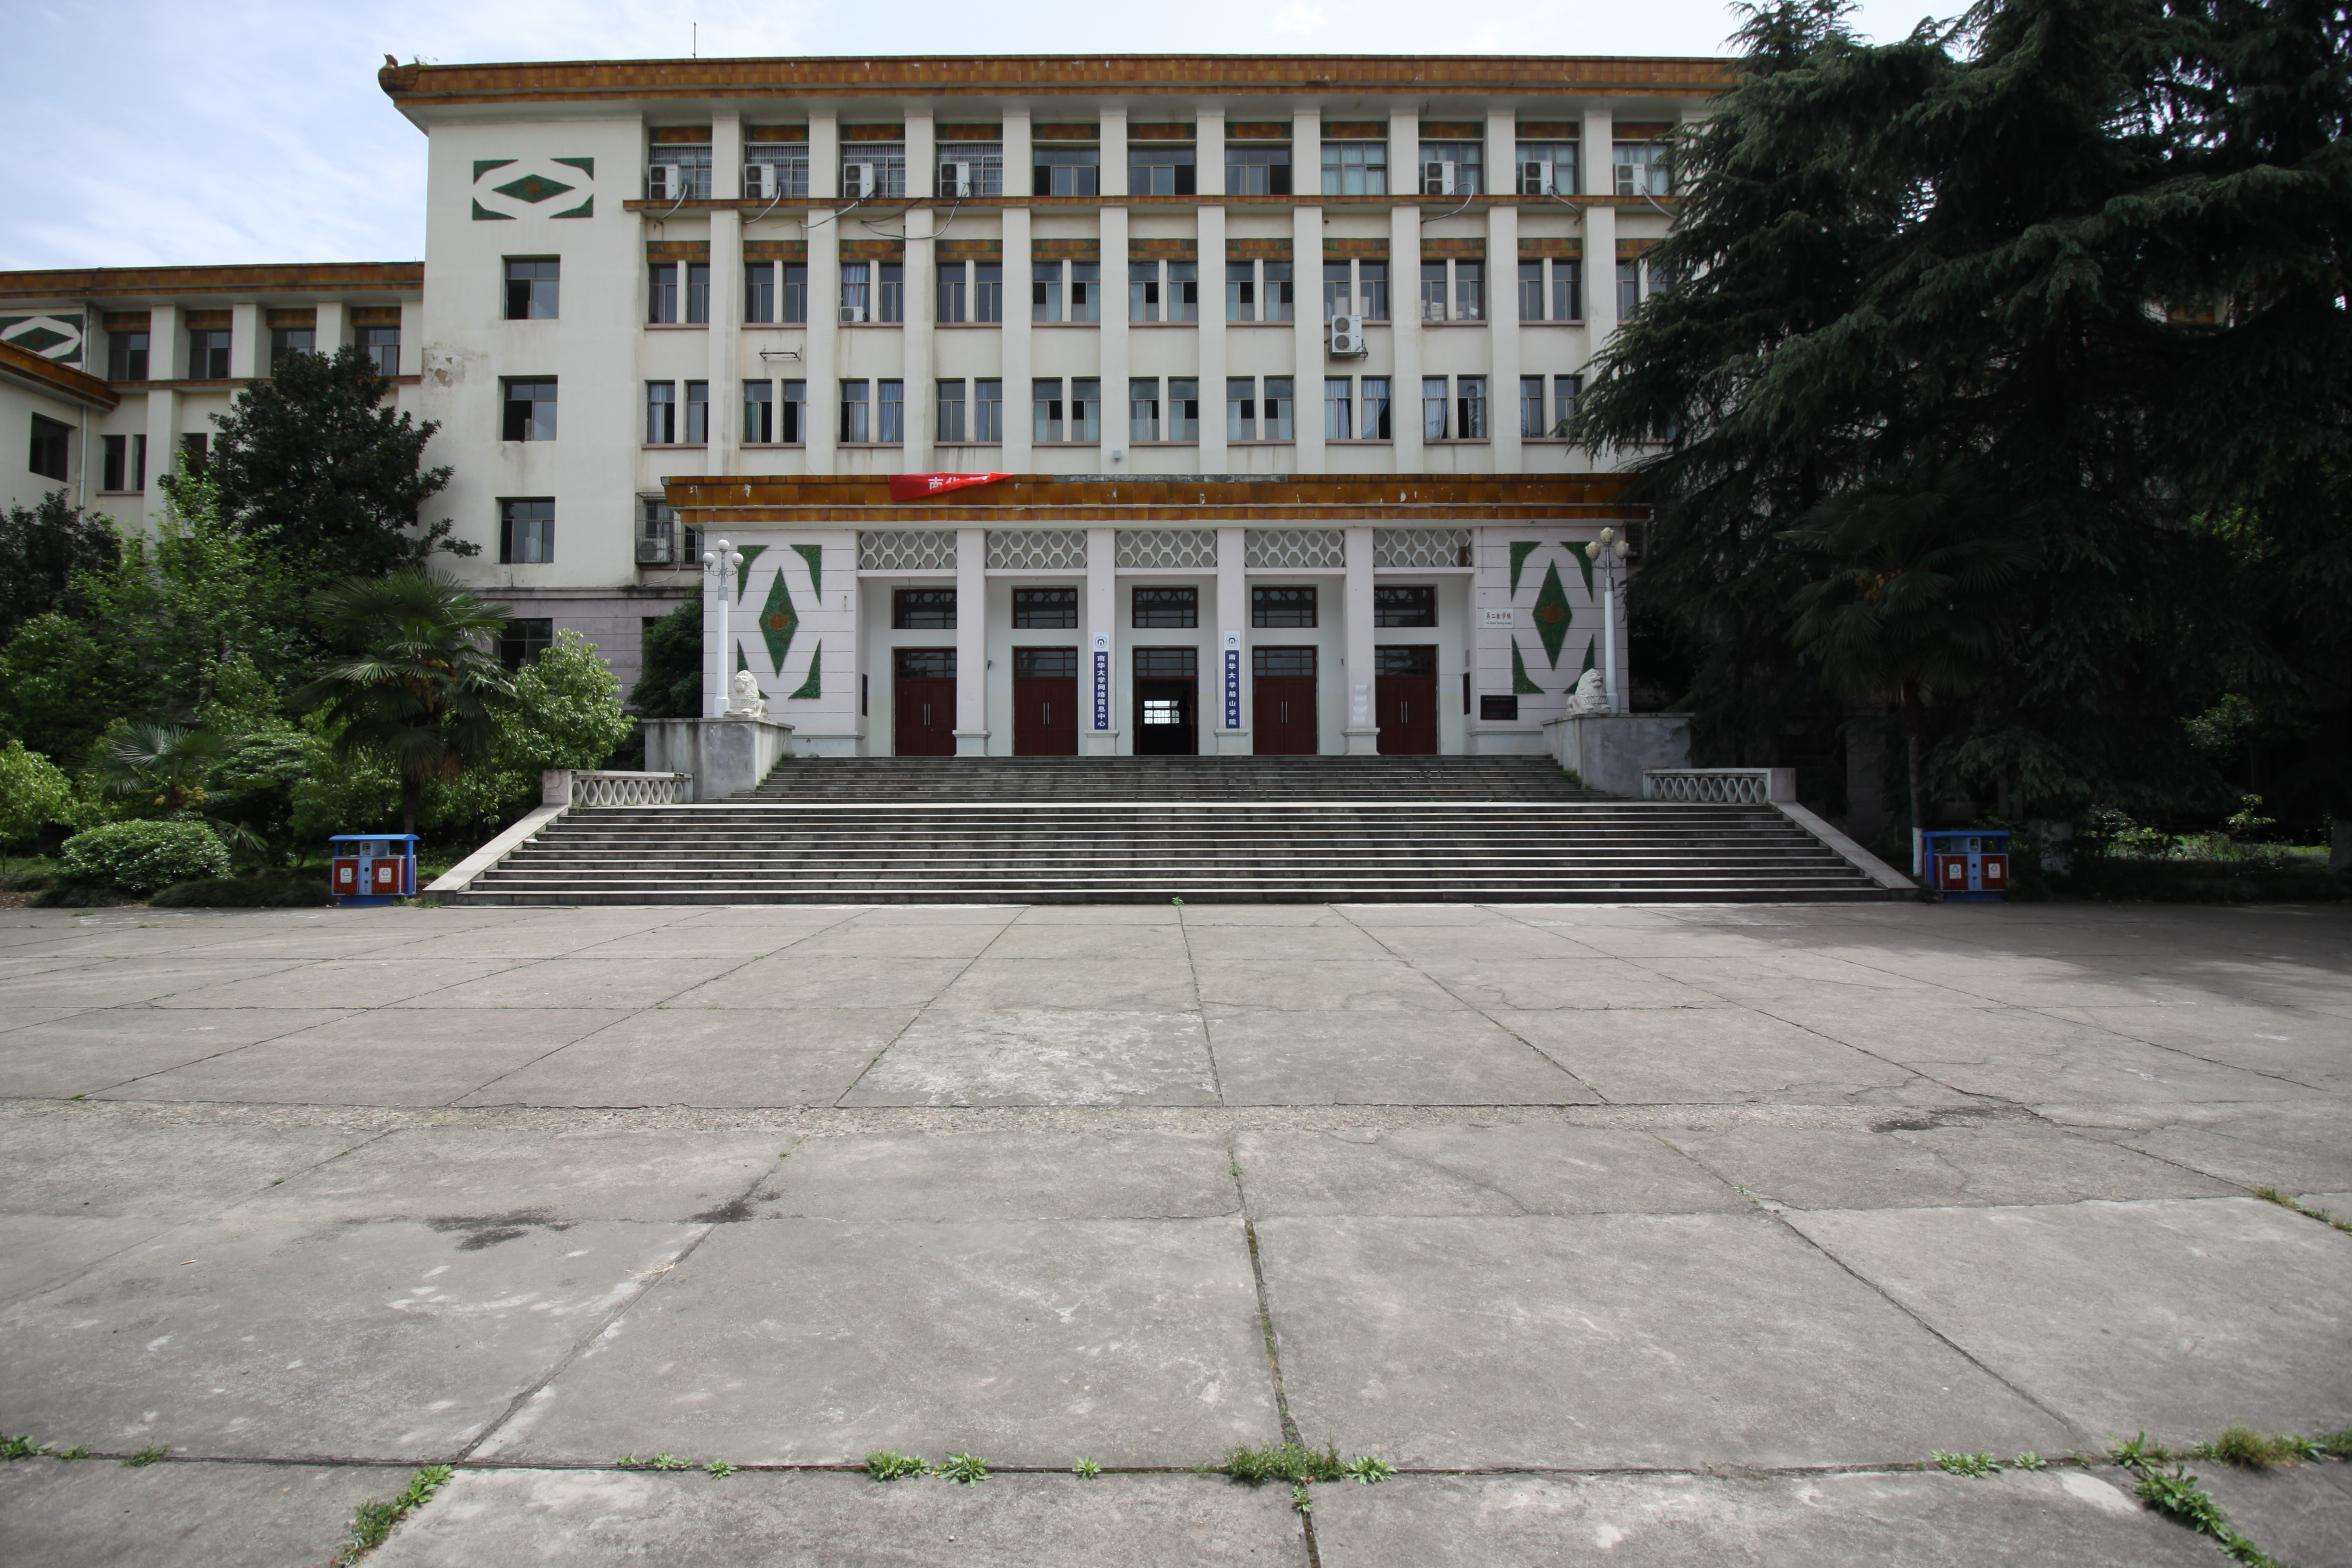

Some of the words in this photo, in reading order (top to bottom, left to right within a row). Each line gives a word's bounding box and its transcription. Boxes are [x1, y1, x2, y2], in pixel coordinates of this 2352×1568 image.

[1096, 655, 1106, 727] 南华大学网络信息中心
[1228, 653, 1237, 726] 南华大学船山学院
